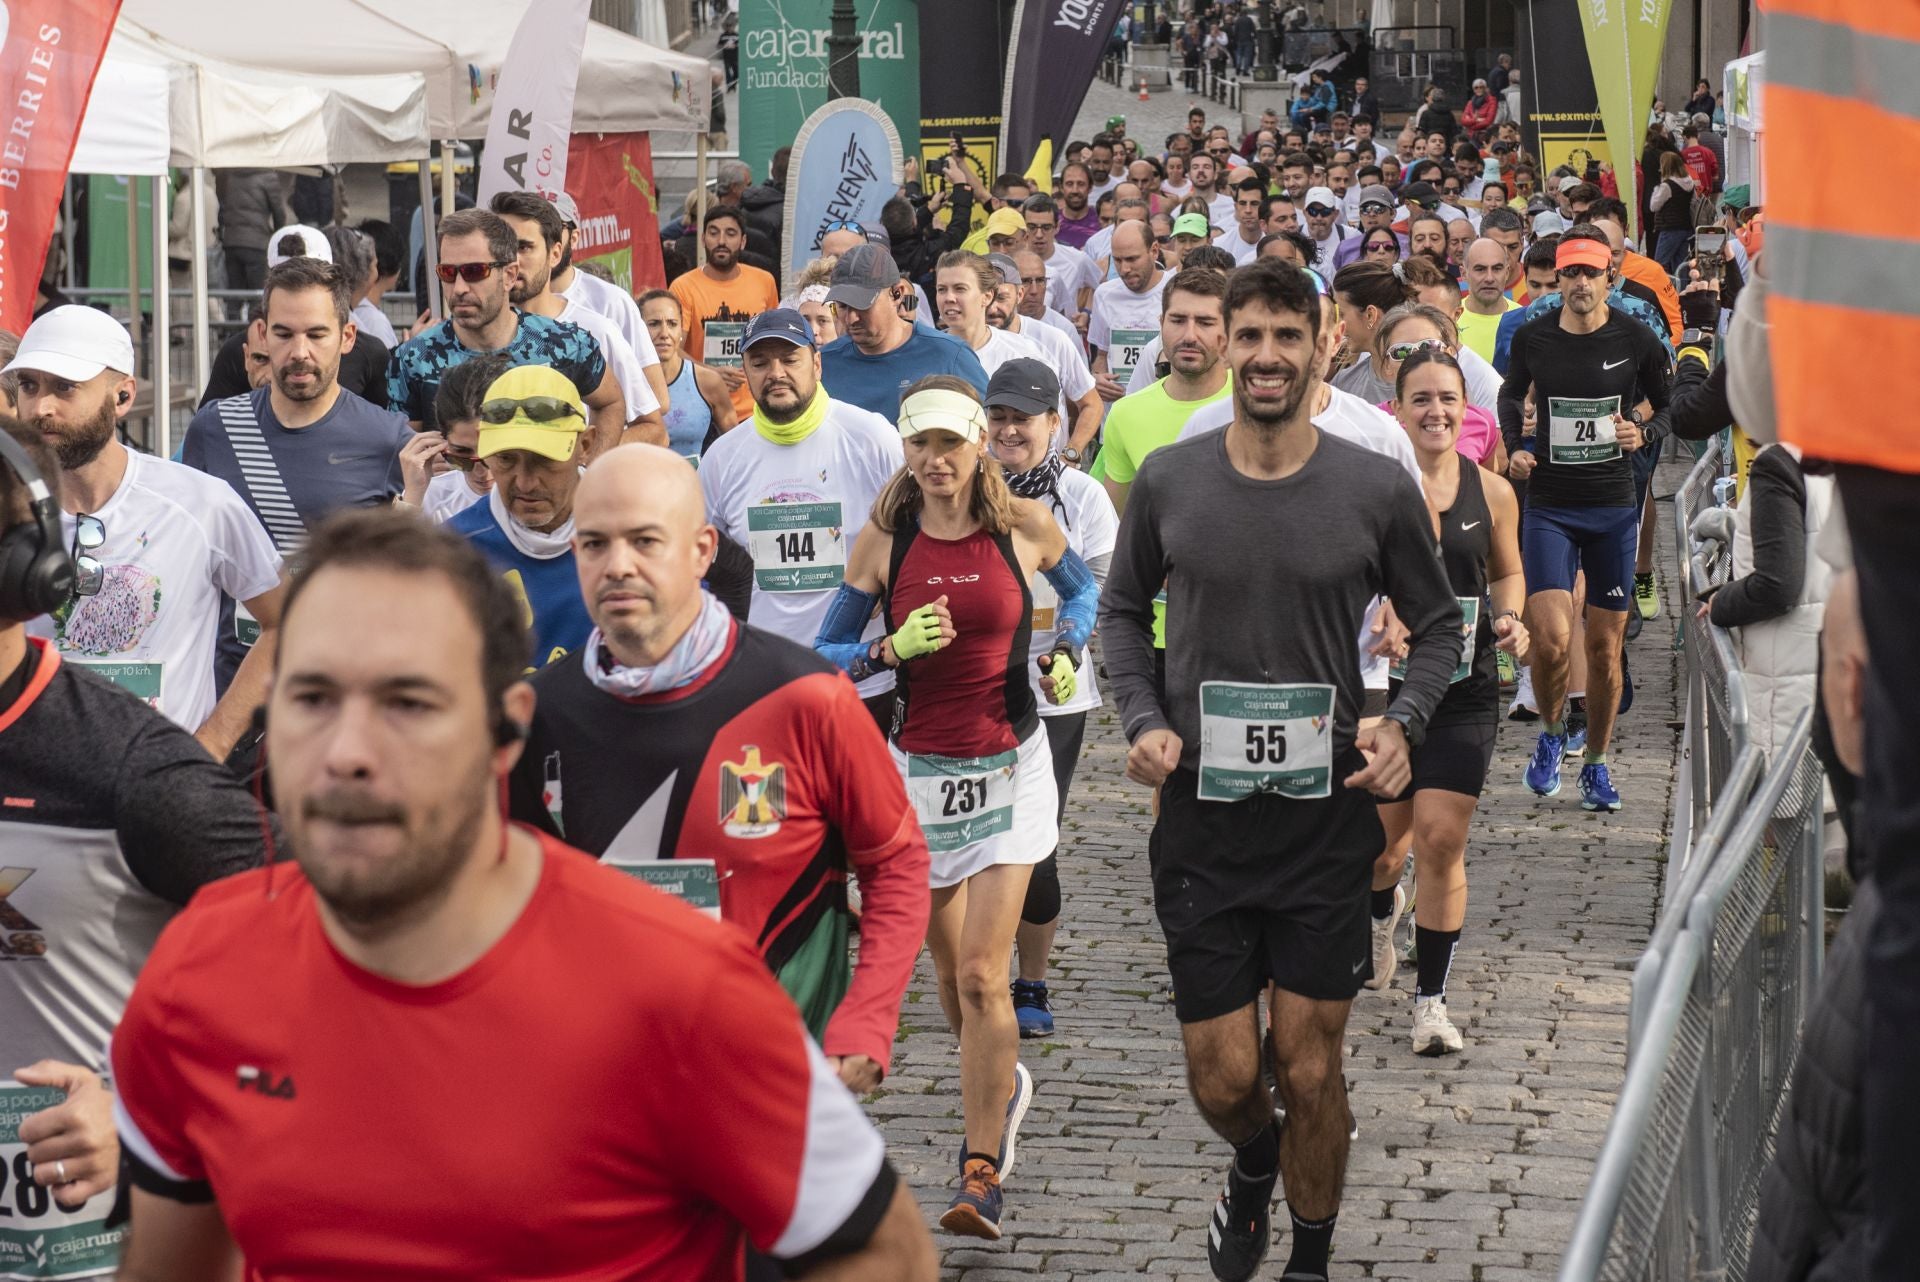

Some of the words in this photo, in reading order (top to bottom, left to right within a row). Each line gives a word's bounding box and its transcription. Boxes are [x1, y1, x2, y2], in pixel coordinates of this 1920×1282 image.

[746, 23, 905, 66] cajarral
[746, 66, 830, 89] Fundaci
[0, 23, 61, 190] BERRIES
[1529, 112, 1602, 122] www.sexmero
[1124, 347, 1144, 366] 25
[1575, 420, 1596, 442] 24
[789, 504, 813, 514] popular
[778, 513, 810, 522] cajarural
[776, 532, 816, 562] 144
[801, 571, 834, 580] cajarural
[123, 666, 134, 676] 10
[1210, 688, 1224, 696] XIII
[1225, 688, 1257, 699] Carrera
[1259, 690, 1294, 701] popular
[1244, 700, 1289, 711] cajarural
[1229, 710, 1261, 718] CONTRA
[1246, 725, 1287, 764] 55
[1216, 777, 1254, 787] cajaviva
[941, 777, 987, 816] 231
[925, 831, 959, 841] cajaviva
[644, 868, 689, 881] popular
[693, 867, 707, 878] 10
[237, 1065, 298, 1101] FILA
[11, 1092, 66, 1109] popula
